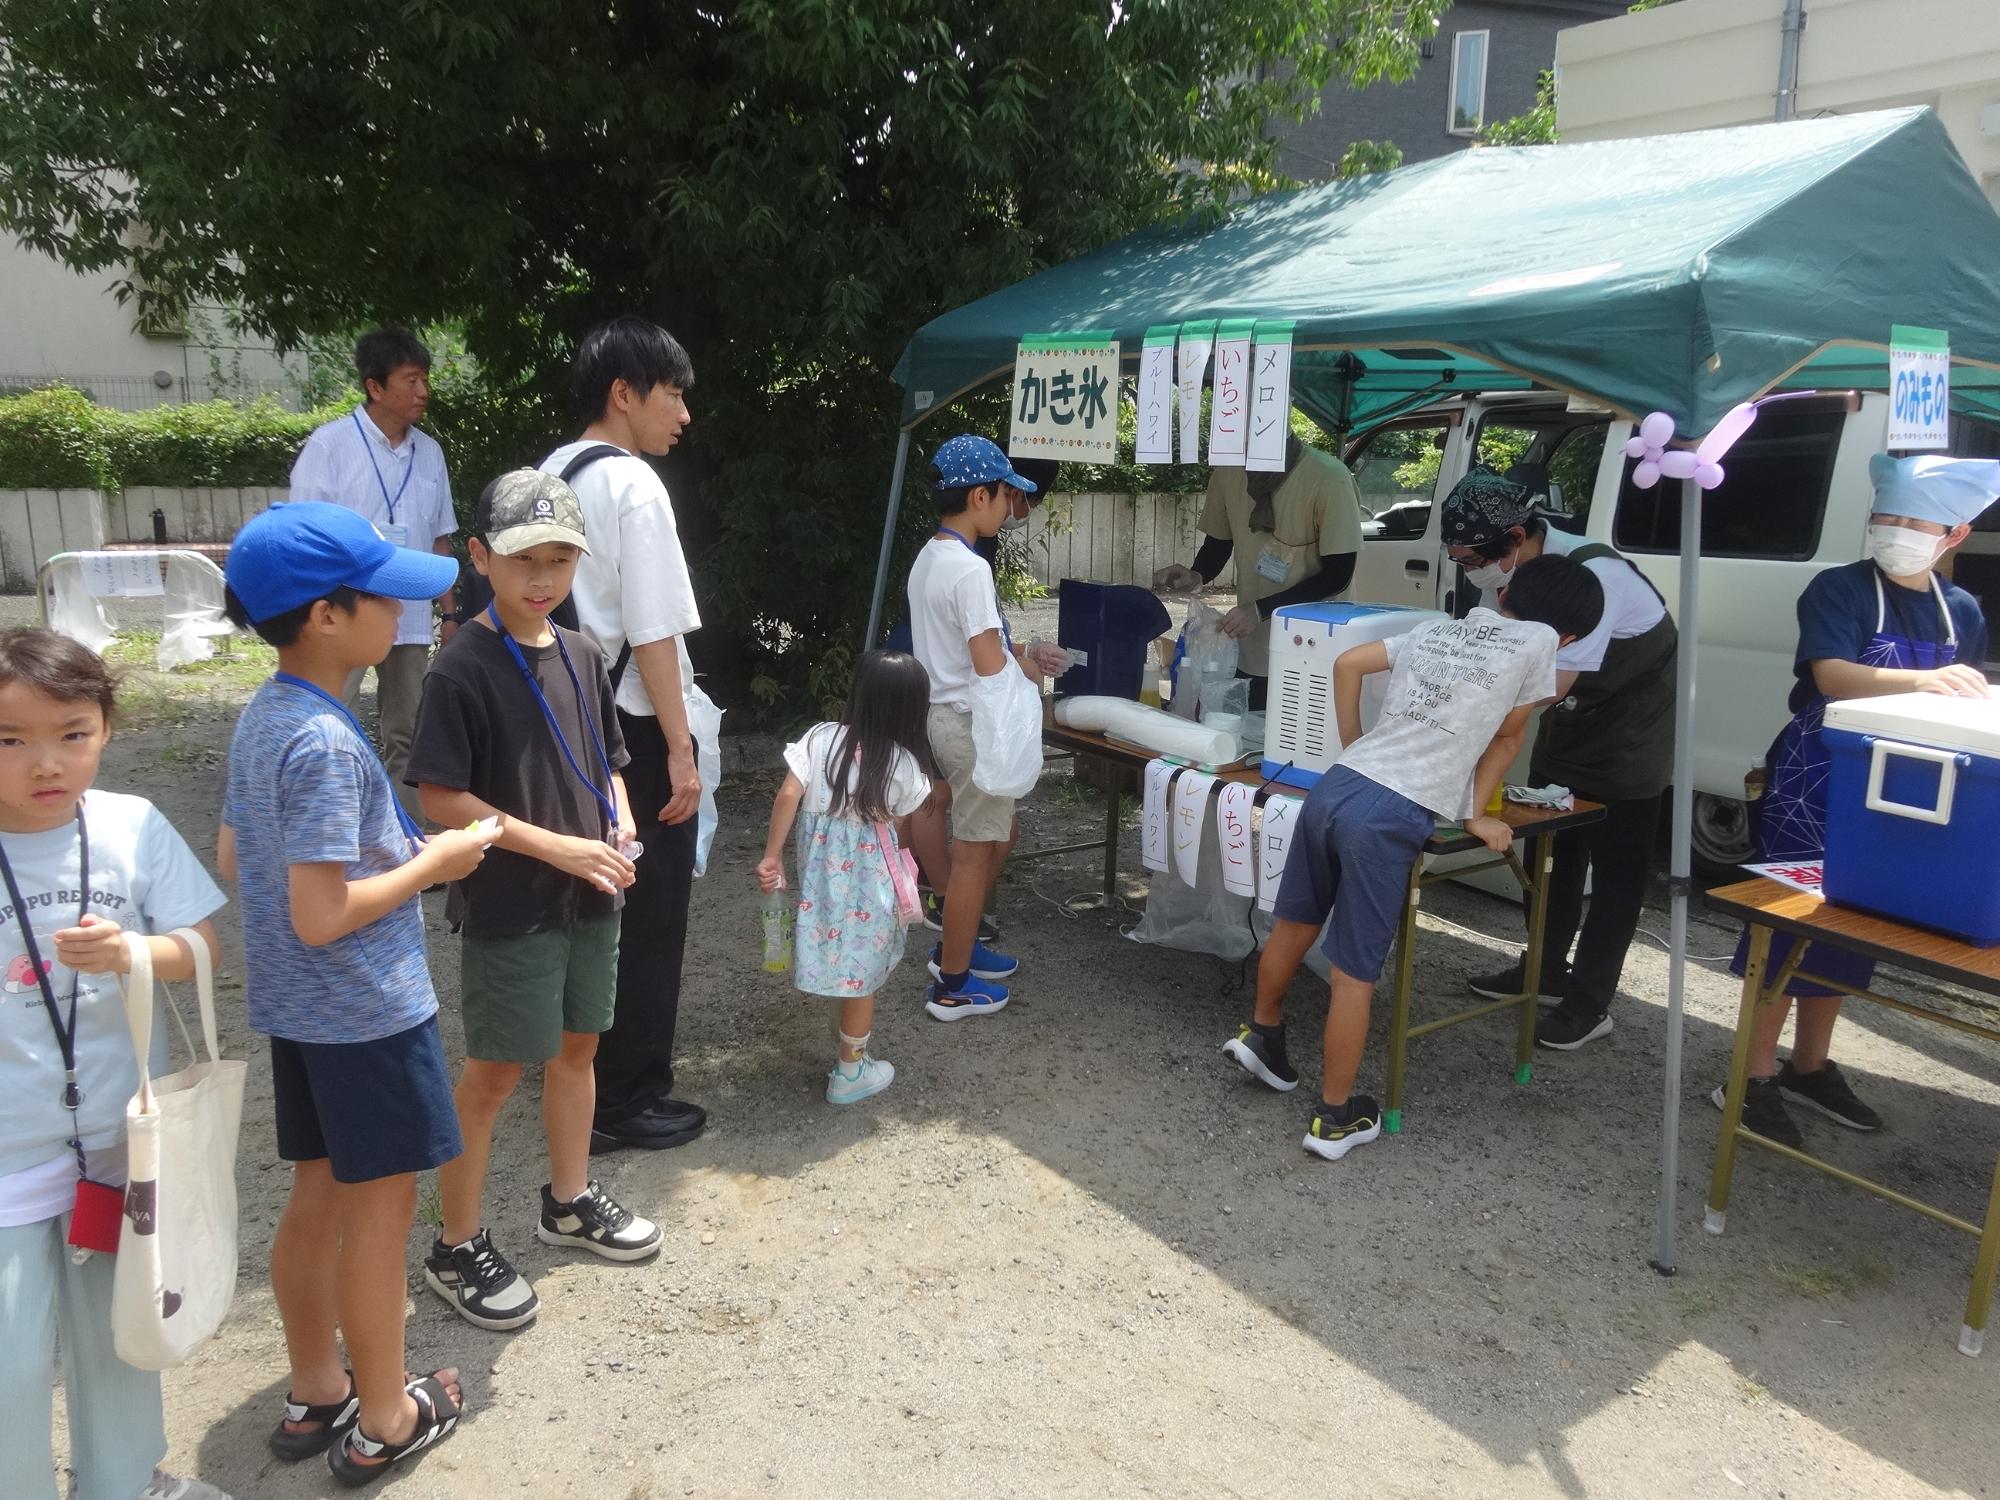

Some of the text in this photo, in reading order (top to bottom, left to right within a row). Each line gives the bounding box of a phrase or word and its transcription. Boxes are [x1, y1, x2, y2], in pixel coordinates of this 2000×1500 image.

[1018, 364, 1109, 429] かき氷
[1181, 350, 1201, 431] レモン
[1218, 349, 1242, 434] いちご
[1254, 349, 1277, 438] メロン
[1895, 369, 1946, 427] のみもの
[1476, 625, 1503, 643] BE
[1178, 779, 1201, 850] レモン
[1225, 786, 1246, 866] いちご
[1265, 804, 1288, 881] メロン
